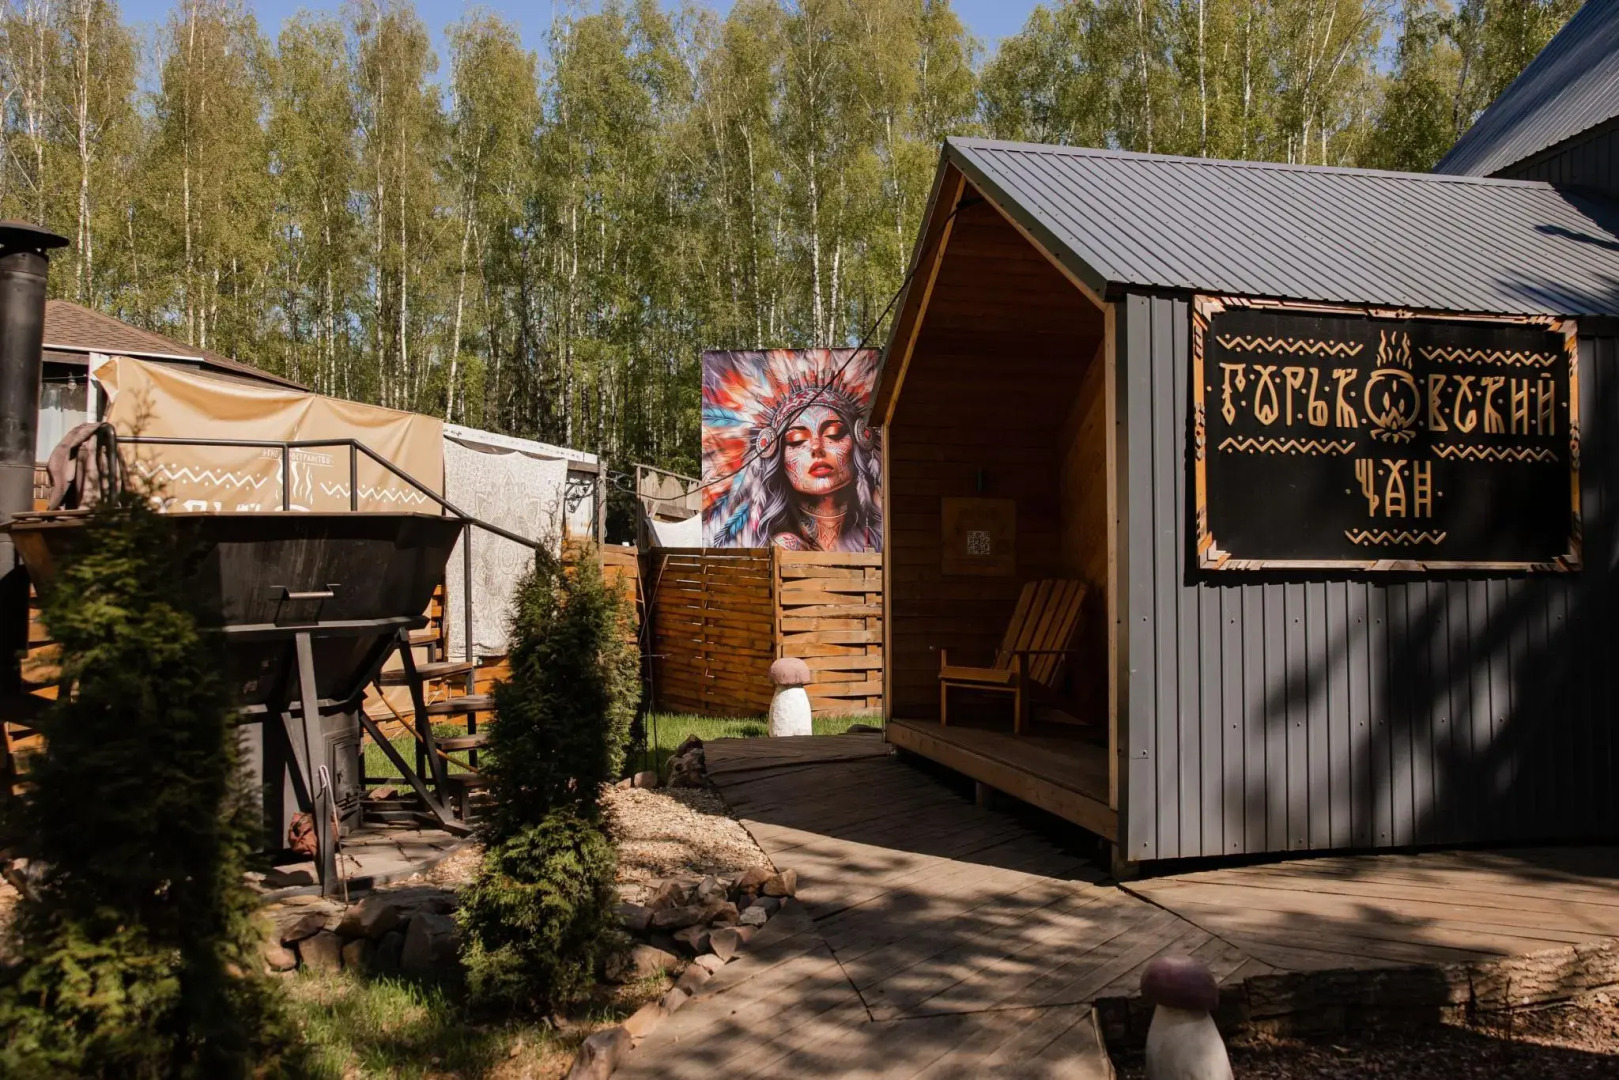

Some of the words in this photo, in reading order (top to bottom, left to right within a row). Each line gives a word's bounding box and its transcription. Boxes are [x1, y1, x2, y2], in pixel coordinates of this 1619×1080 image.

[1219, 361, 1556, 438] ГОРЬКОВСКИЙ
[285, 451, 331, 465] ОСТРАНСТВО
[1355, 458, 1432, 518] ЧАН
